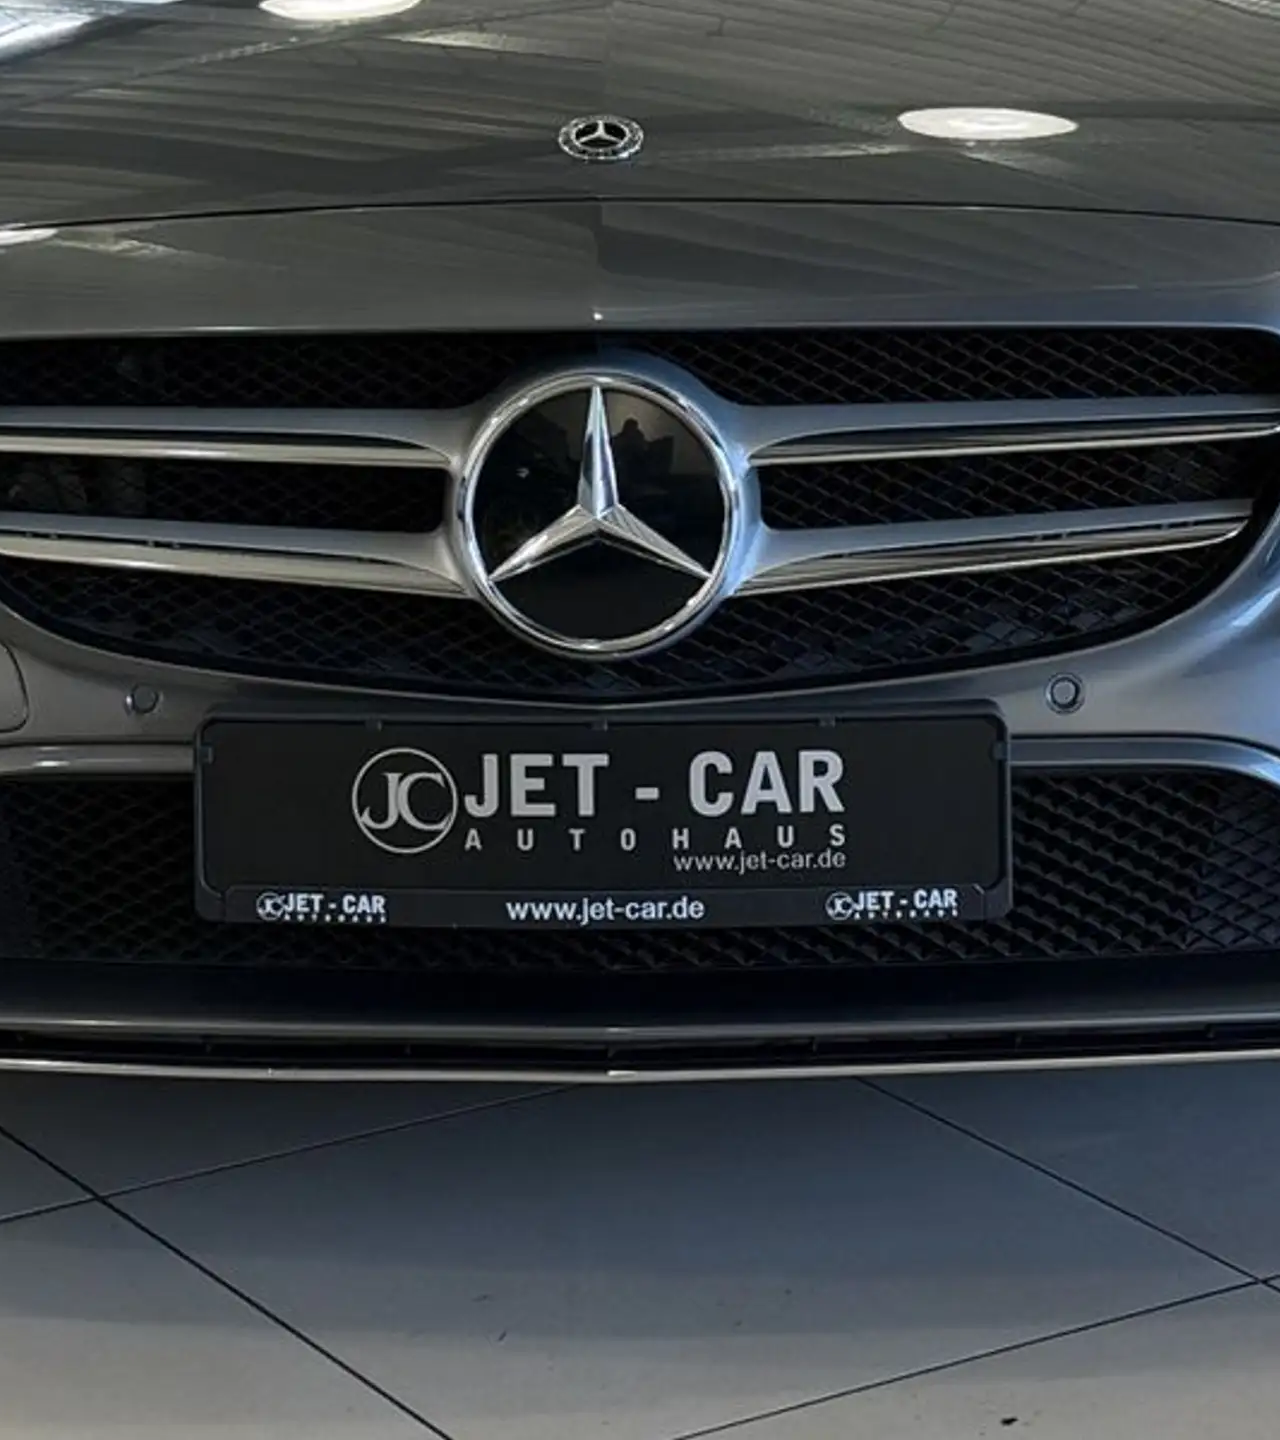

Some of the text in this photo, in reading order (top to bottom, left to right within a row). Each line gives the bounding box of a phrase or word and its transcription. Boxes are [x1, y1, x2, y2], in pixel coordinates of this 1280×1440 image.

[464, 752, 610, 819] JET
[688, 749, 845, 818] CAR
[359, 771, 455, 831] JC
[464, 823, 846, 852] AUTOHAUS
[673, 849, 847, 876] www.jet-car.de
[284, 892, 325, 913] JET
[342, 894, 387, 914] CAR
[505, 895, 705, 927] www.jet-car.de
[853, 890, 895, 911] JET
[913, 888, 958, 909] CAR
